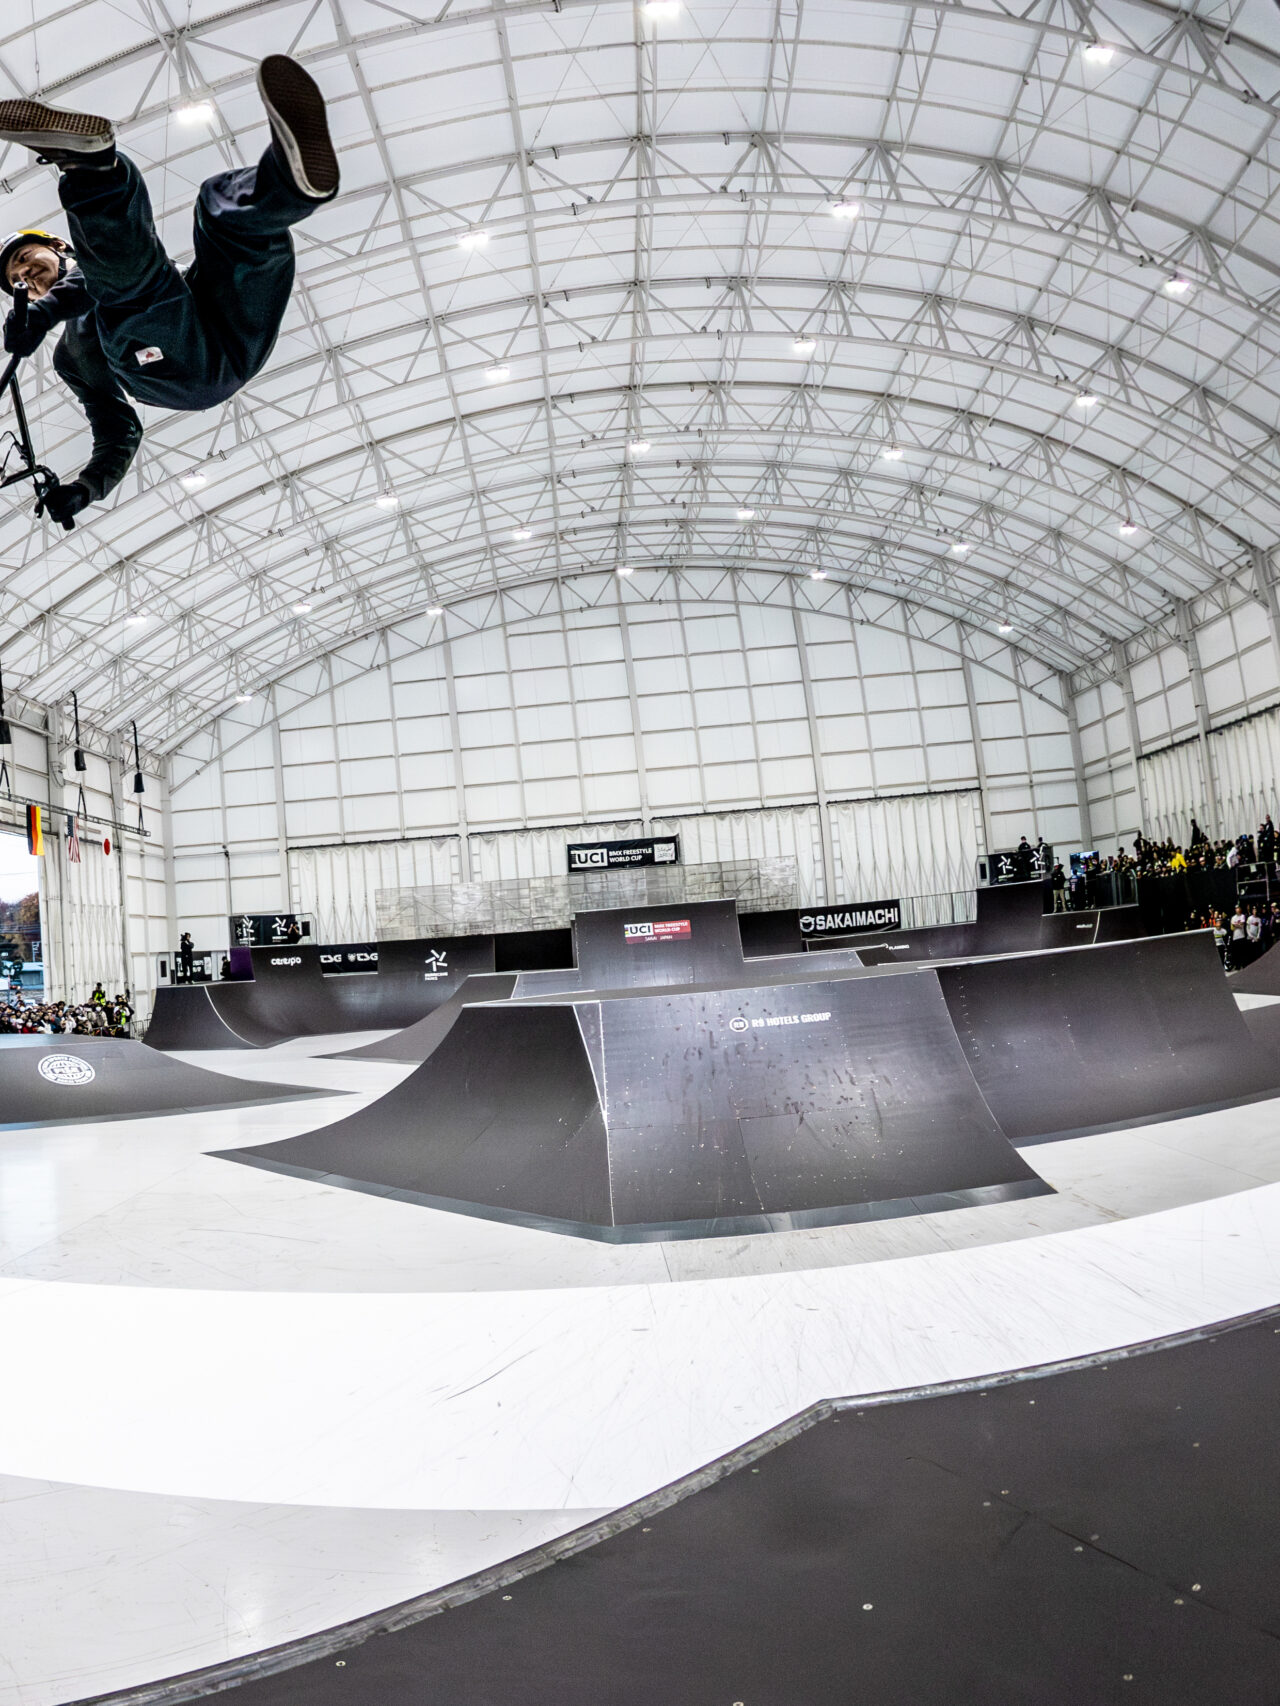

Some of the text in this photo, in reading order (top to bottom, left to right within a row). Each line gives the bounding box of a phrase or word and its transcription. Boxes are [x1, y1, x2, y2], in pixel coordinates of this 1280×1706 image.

[577, 852, 605, 864] UCI
[623, 847, 653, 856] FREESTYLE
[631, 854, 643, 862] CUP
[815, 907, 899, 930] SAKAIMACHI
[629, 925, 651, 935] UCI
[766, 1015, 800, 1026] HOTELS
[800, 1012, 832, 1023] GROUP
